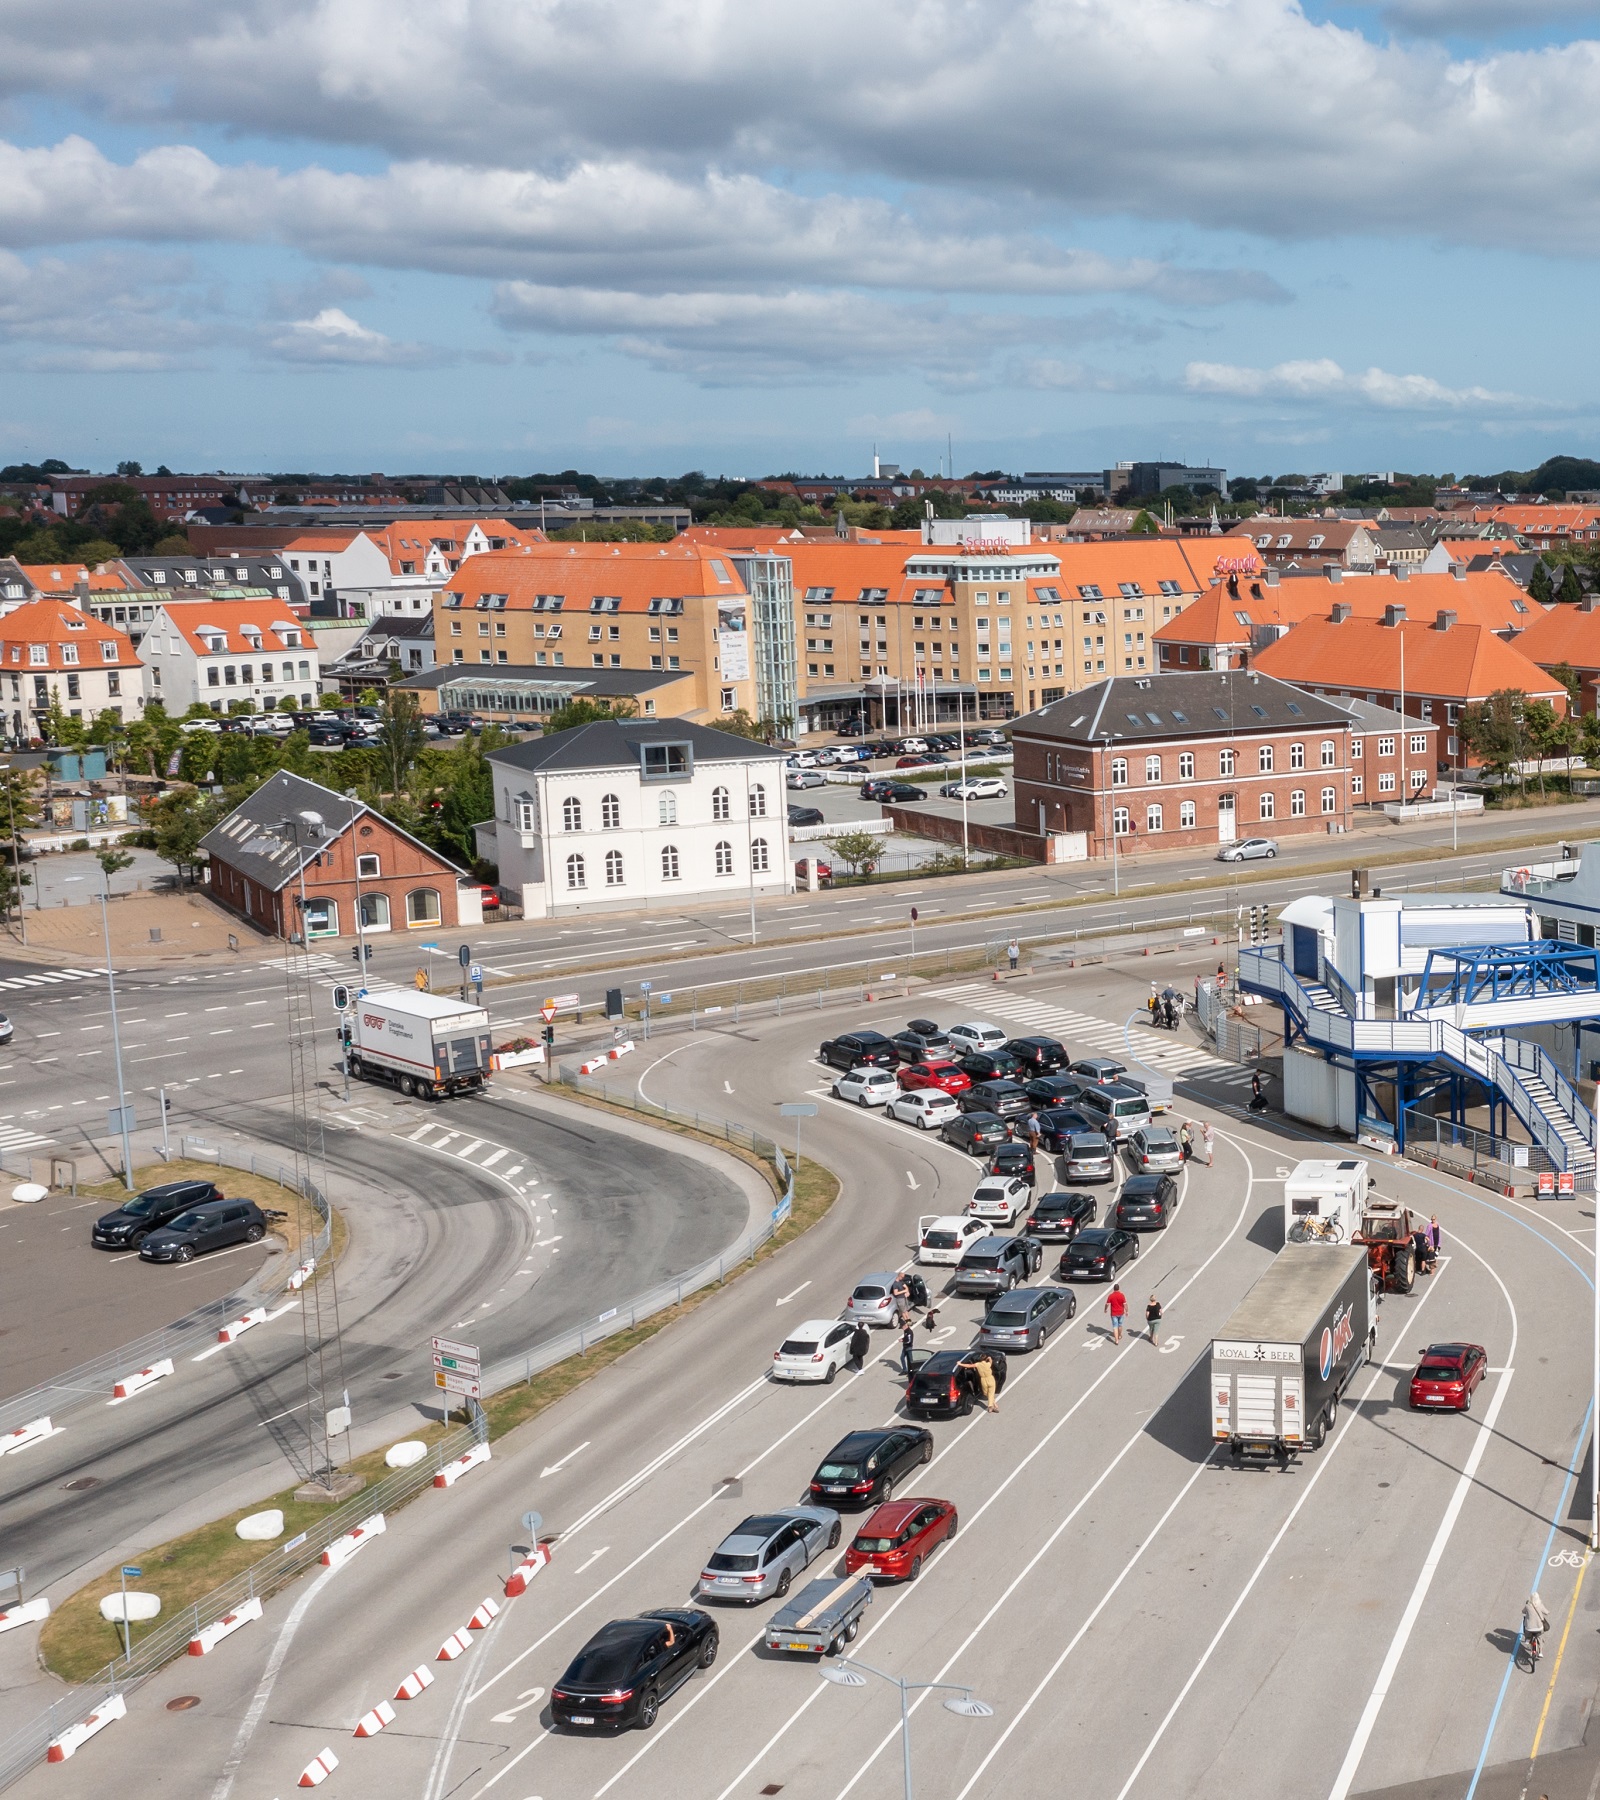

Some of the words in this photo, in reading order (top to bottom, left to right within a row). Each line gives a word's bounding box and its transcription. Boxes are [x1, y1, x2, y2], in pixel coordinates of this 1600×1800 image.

[966, 536, 1009, 546] Scandic
[1217, 554, 1259, 570] Scandic
[388, 1019, 405, 1030] Danske
[388, 1026, 413, 1039] Fragtmænd
[1275, 1166, 1291, 1179] 5
[926, 1326, 957, 1345] 2
[1081, 1332, 1110, 1351] 4
[441, 1342, 460, 1352] Centrum
[1158, 1335, 1186, 1354] 5
[1219, 1348, 1251, 1359] ROYAL
[1270, 1351, 1296, 1361] BEER
[574, 1546, 611, 1574] 1
[490, 1686, 546, 1723] 2
